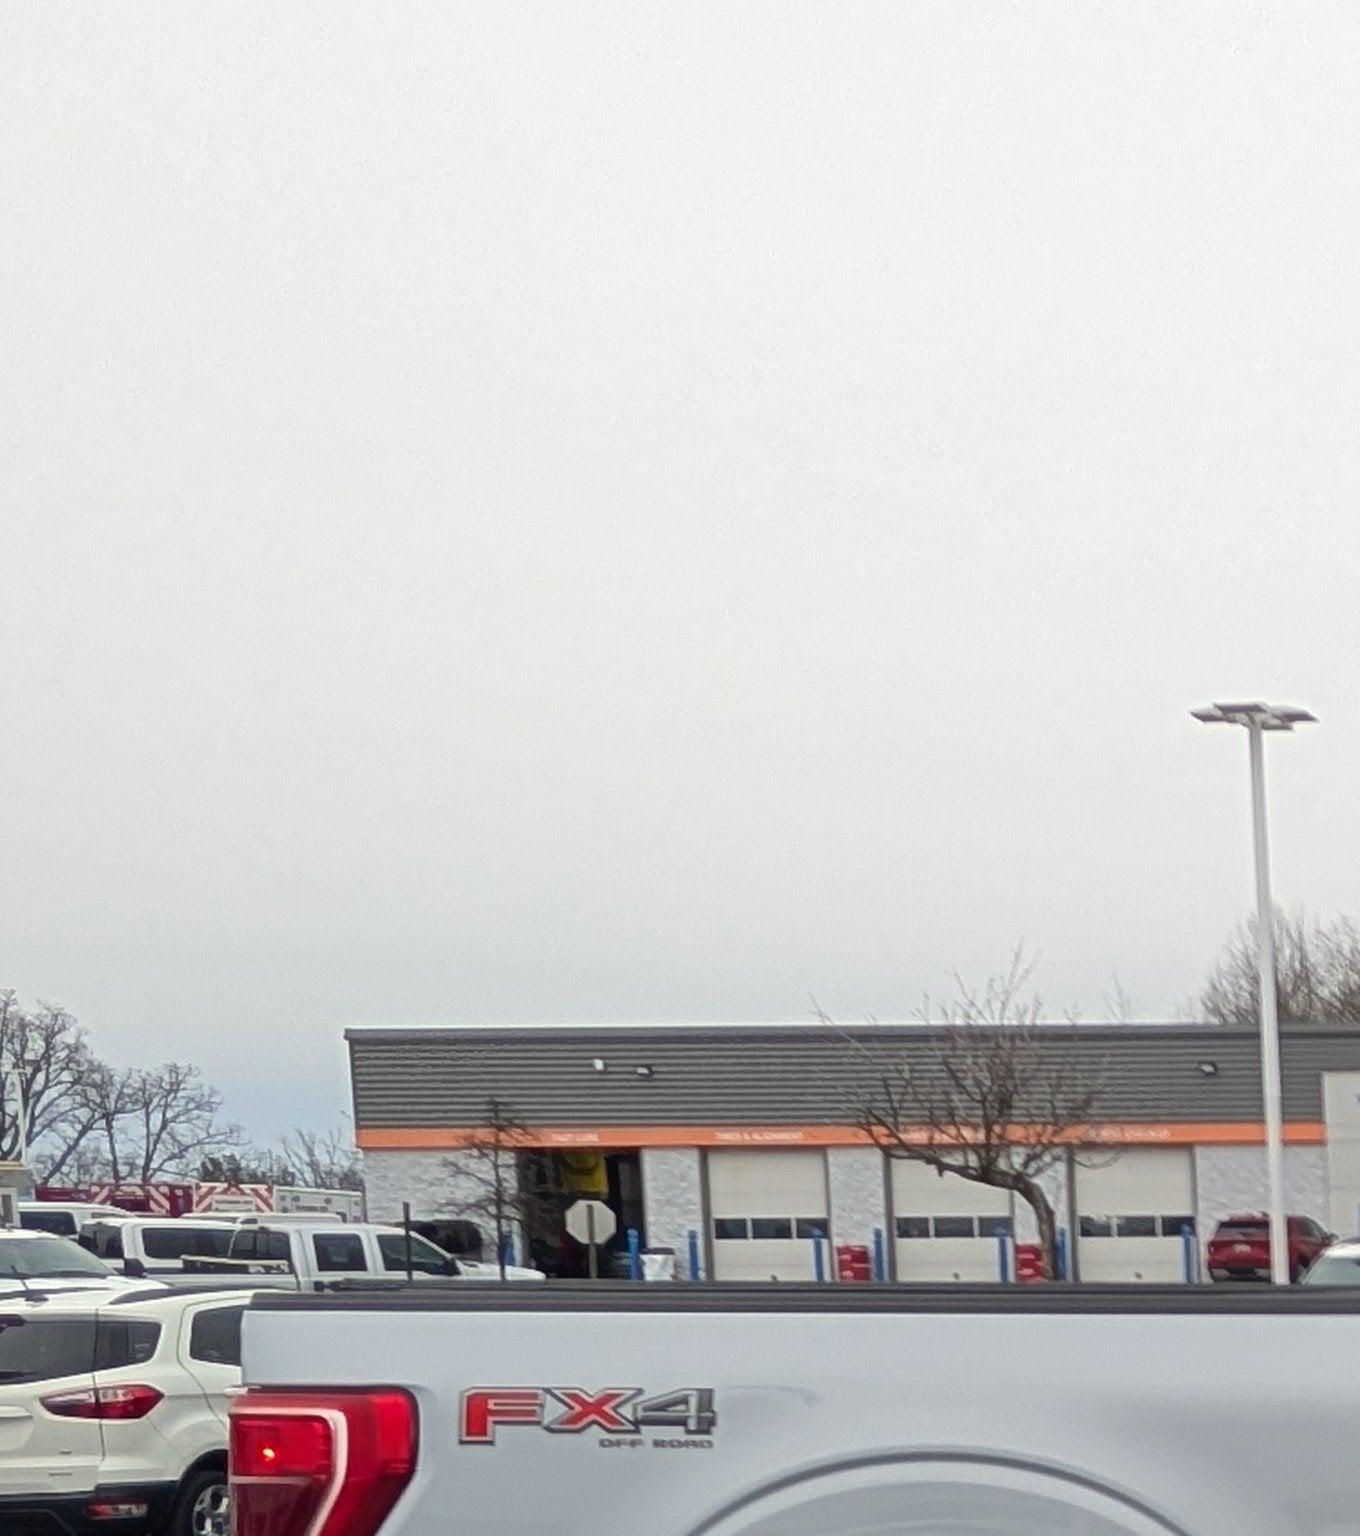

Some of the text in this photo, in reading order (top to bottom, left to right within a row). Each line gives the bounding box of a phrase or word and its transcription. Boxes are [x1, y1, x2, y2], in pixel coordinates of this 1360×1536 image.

[459, 1386, 717, 1445] FX4
[598, 1438, 714, 1449] OFF ROAD
